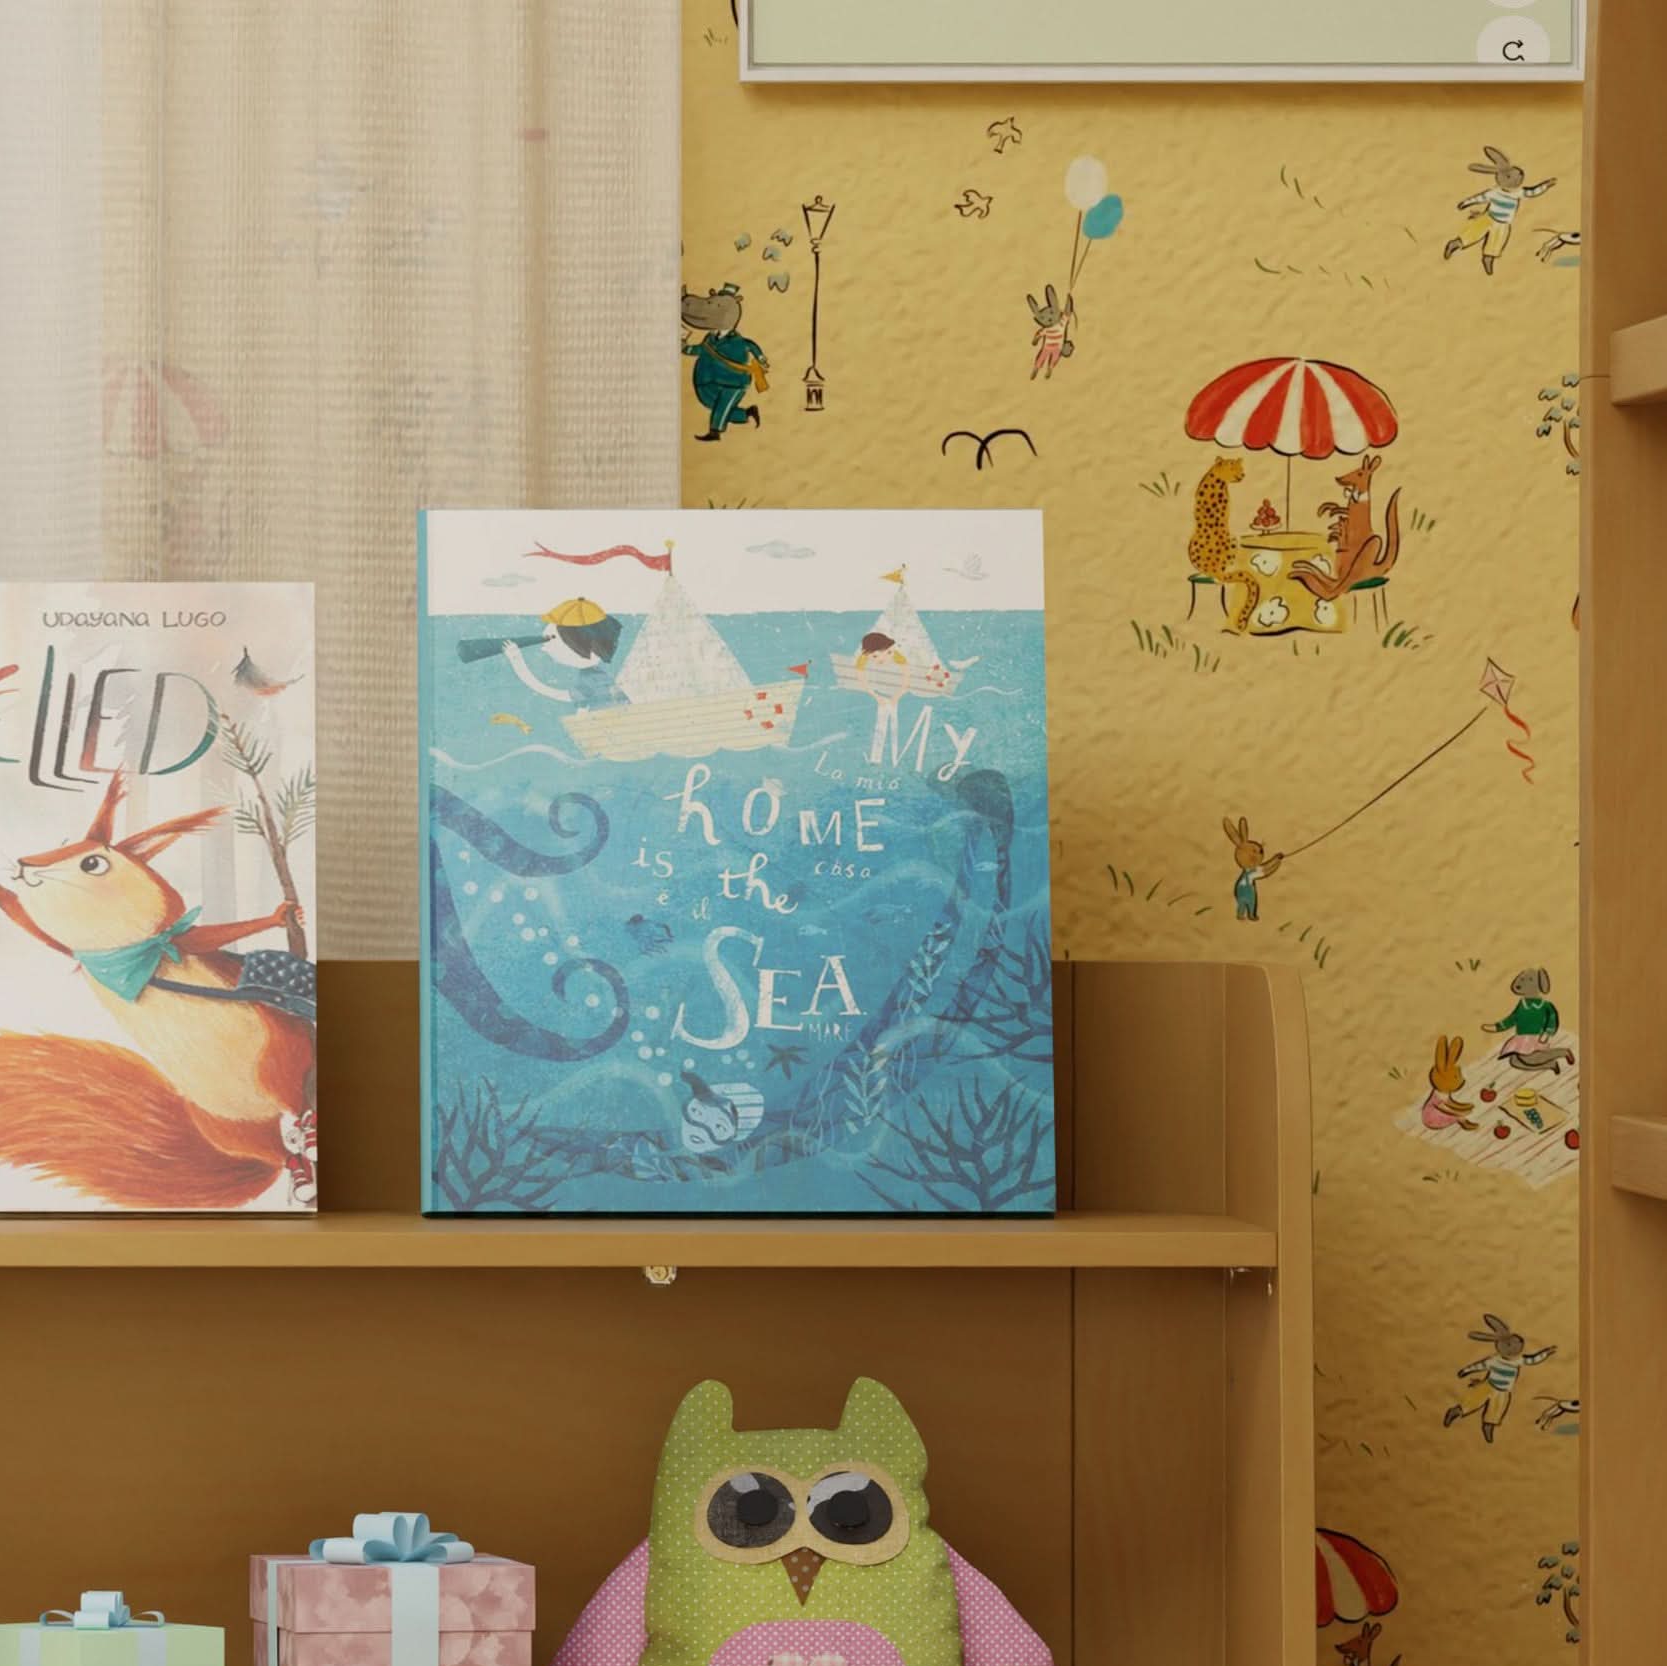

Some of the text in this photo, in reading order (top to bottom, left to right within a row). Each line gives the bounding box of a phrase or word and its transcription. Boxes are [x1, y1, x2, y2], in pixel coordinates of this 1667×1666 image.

[162, 611, 227, 629] LUGO
[865, 703, 977, 782] My
[630, 837, 799, 915] is the
[671, 925, 863, 1050] SEA
